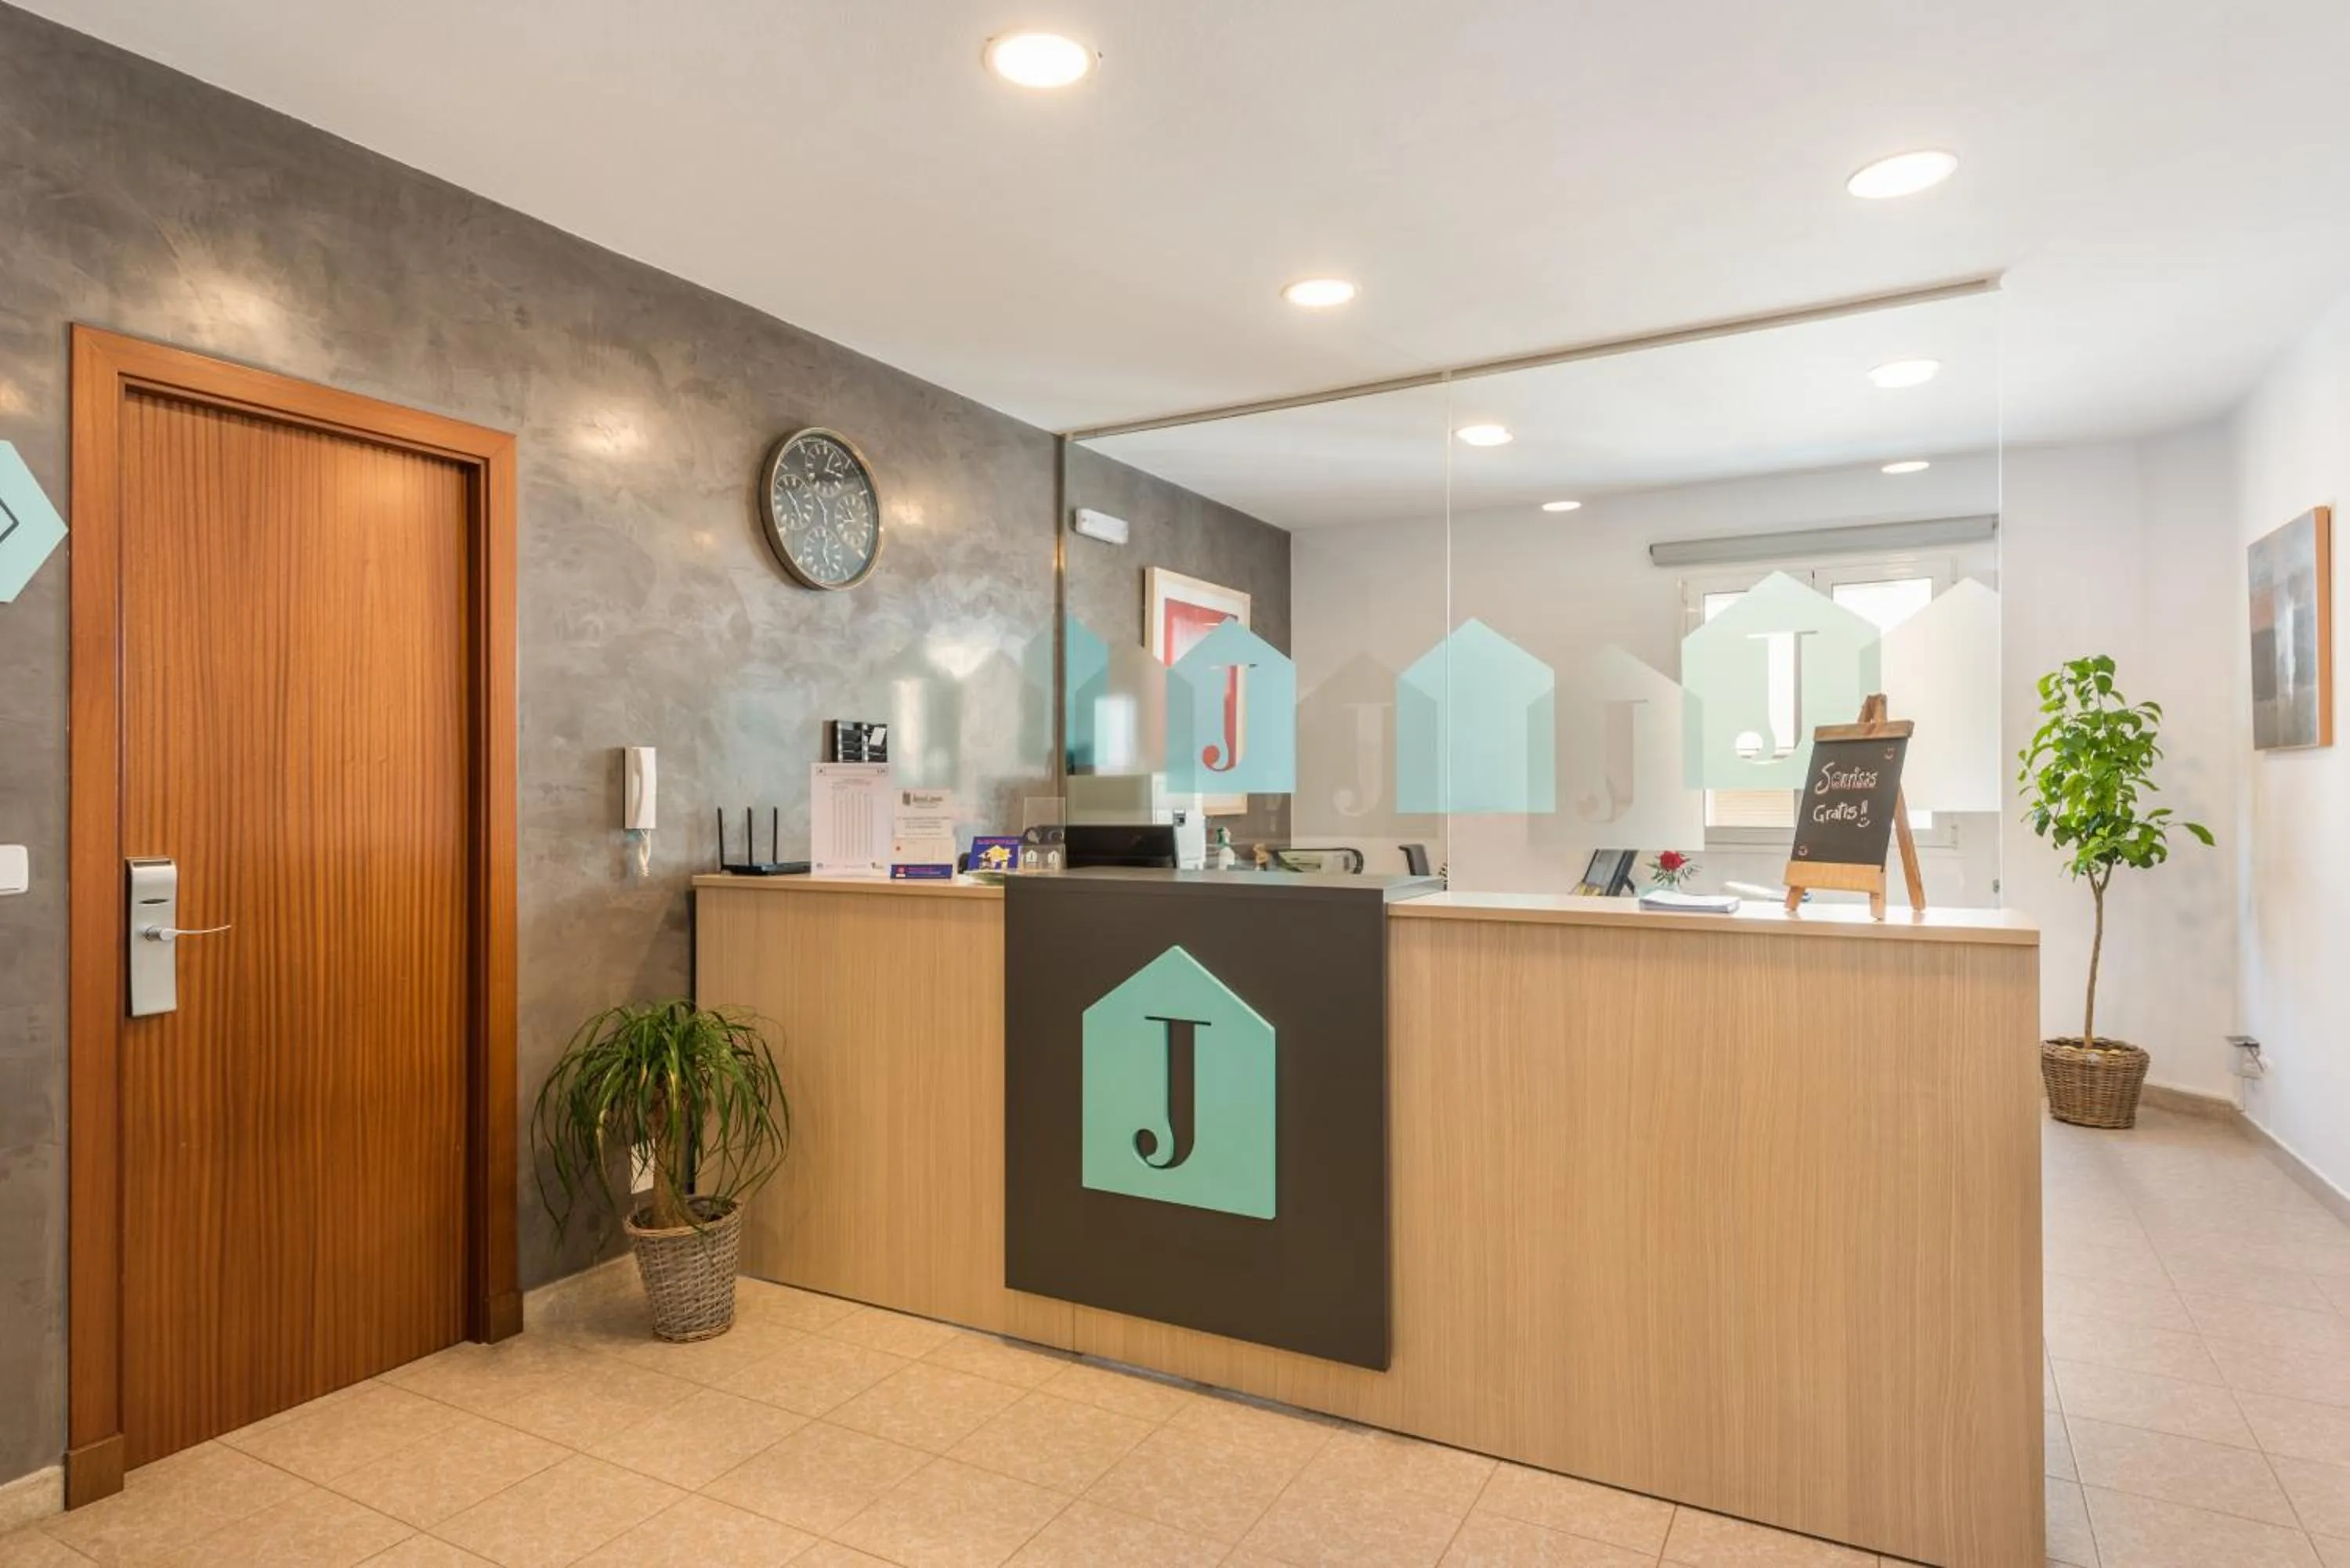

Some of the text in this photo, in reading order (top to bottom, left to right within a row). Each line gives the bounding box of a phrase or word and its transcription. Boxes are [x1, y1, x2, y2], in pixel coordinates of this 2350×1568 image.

[1202, 663, 1258, 771] J
[1735, 630, 1818, 764] J
[1133, 1016, 1211, 1169] J
